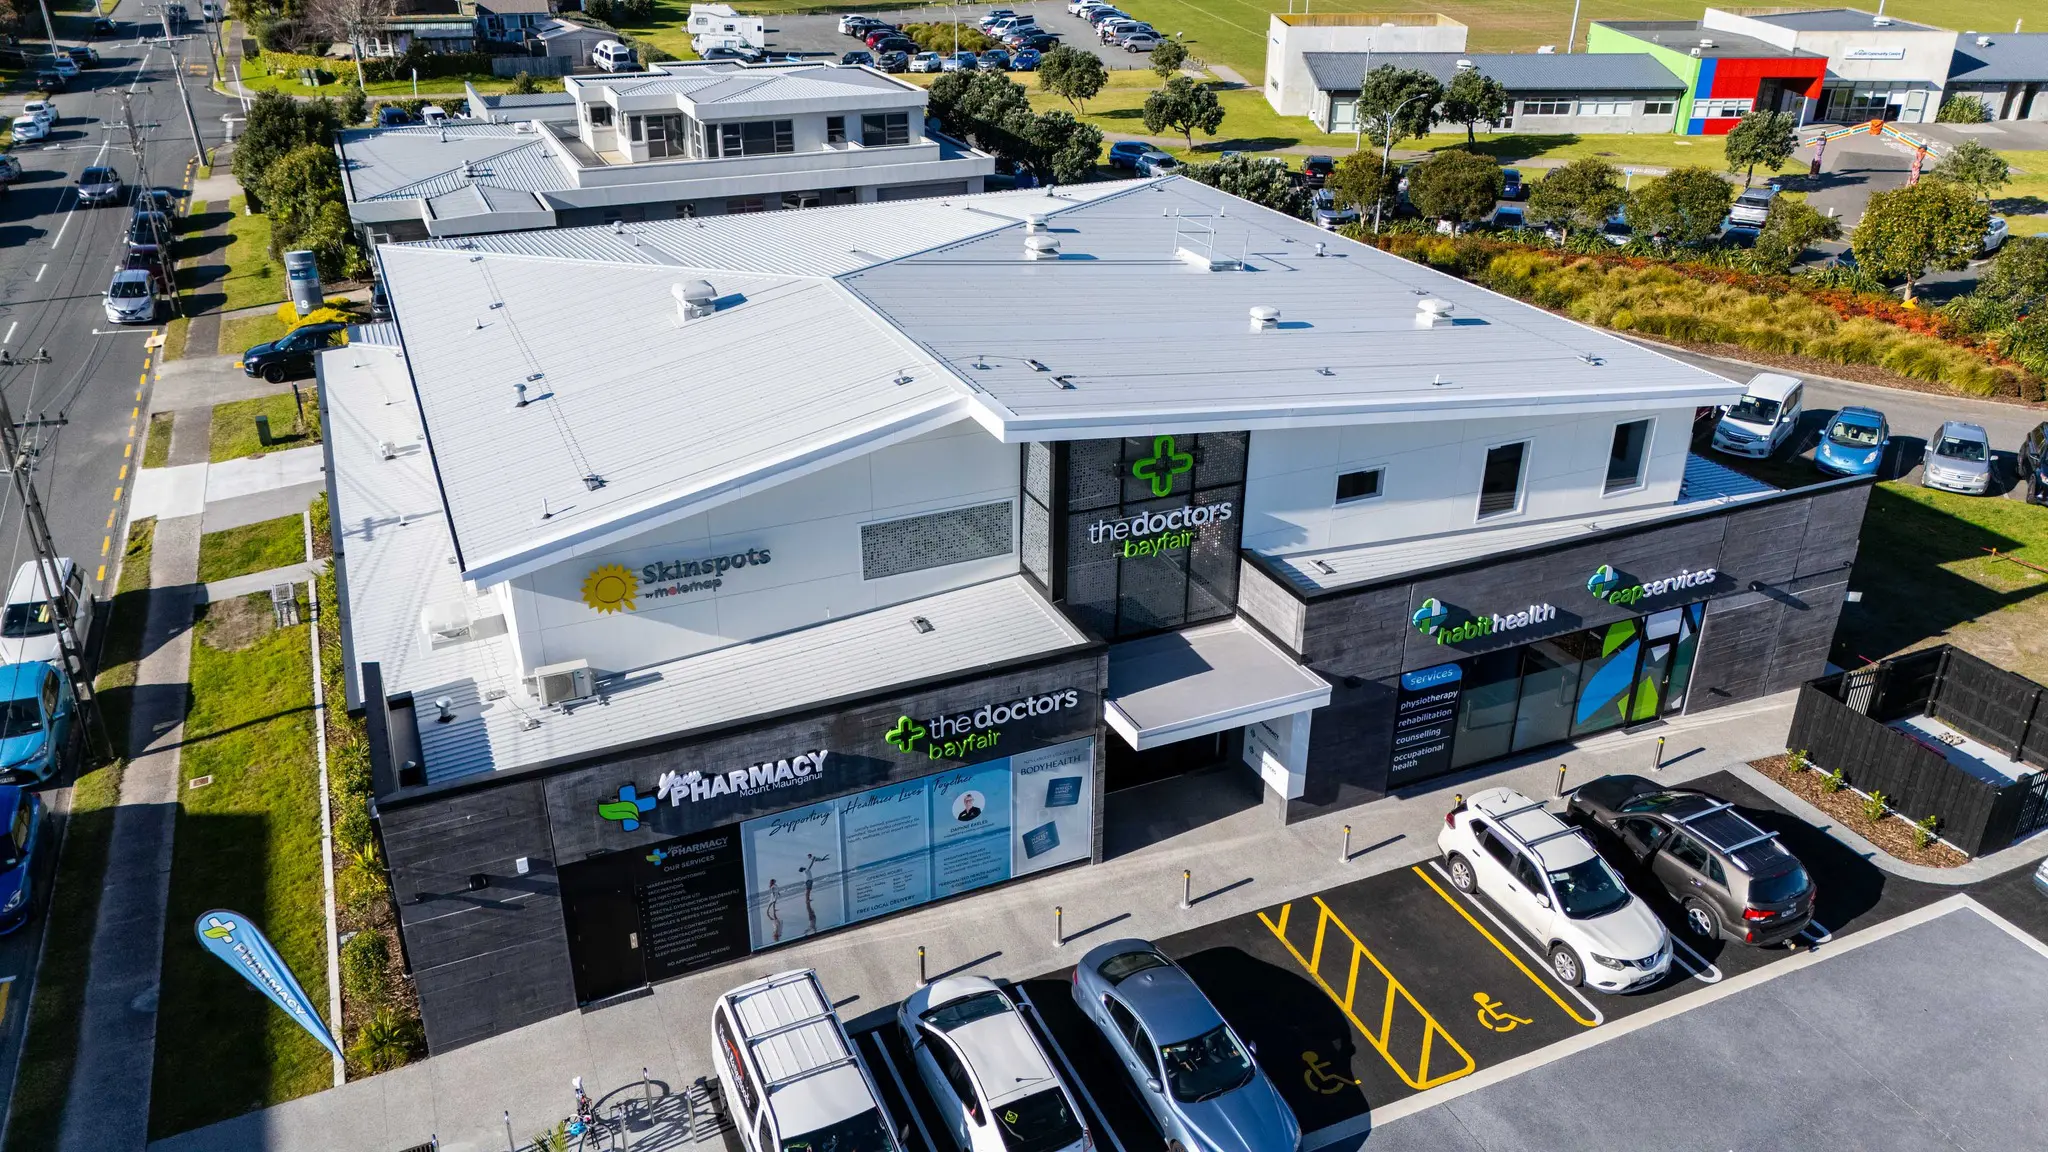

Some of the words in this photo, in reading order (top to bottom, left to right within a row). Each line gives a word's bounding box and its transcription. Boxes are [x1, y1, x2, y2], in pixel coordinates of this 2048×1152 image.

[1124, 530, 1195, 558] bayfair
[642, 548, 772, 585] Skinspots
[1609, 568, 1716, 605] eapservices
[1436, 603, 1556, 646] habithealth
[1410, 668, 1453, 686] services
[1400, 690, 1458, 711] physiotherapy
[1398, 709, 1452, 728] rehabilitation
[929, 730, 1001, 760] bayfair
[1396, 728, 1441, 745] counselling
[1394, 743, 1444, 762] occupational
[1020, 754, 1081, 776] BODYHEALTH
[1392, 760, 1418, 772] health
[658, 770, 702, 800] Your
[670, 750, 828, 807] PHARMACY
[739, 783, 771, 798] Mount
[772, 772, 822, 790] Maunganui
[769, 810, 832, 836] Supporting
[840, 794, 894, 815] Healthier
[934, 774, 972, 795] Together
[671, 836, 728, 857] PHARMACY
[664, 863, 680, 872] OUR
[681, 854, 715, 868] SERVICES
[857, 906, 869, 914] FREE
[871, 902, 888, 911] LOCAL
[890, 894, 916, 906] DELIVERY
[233, 941, 306, 1015] PHARMACY
